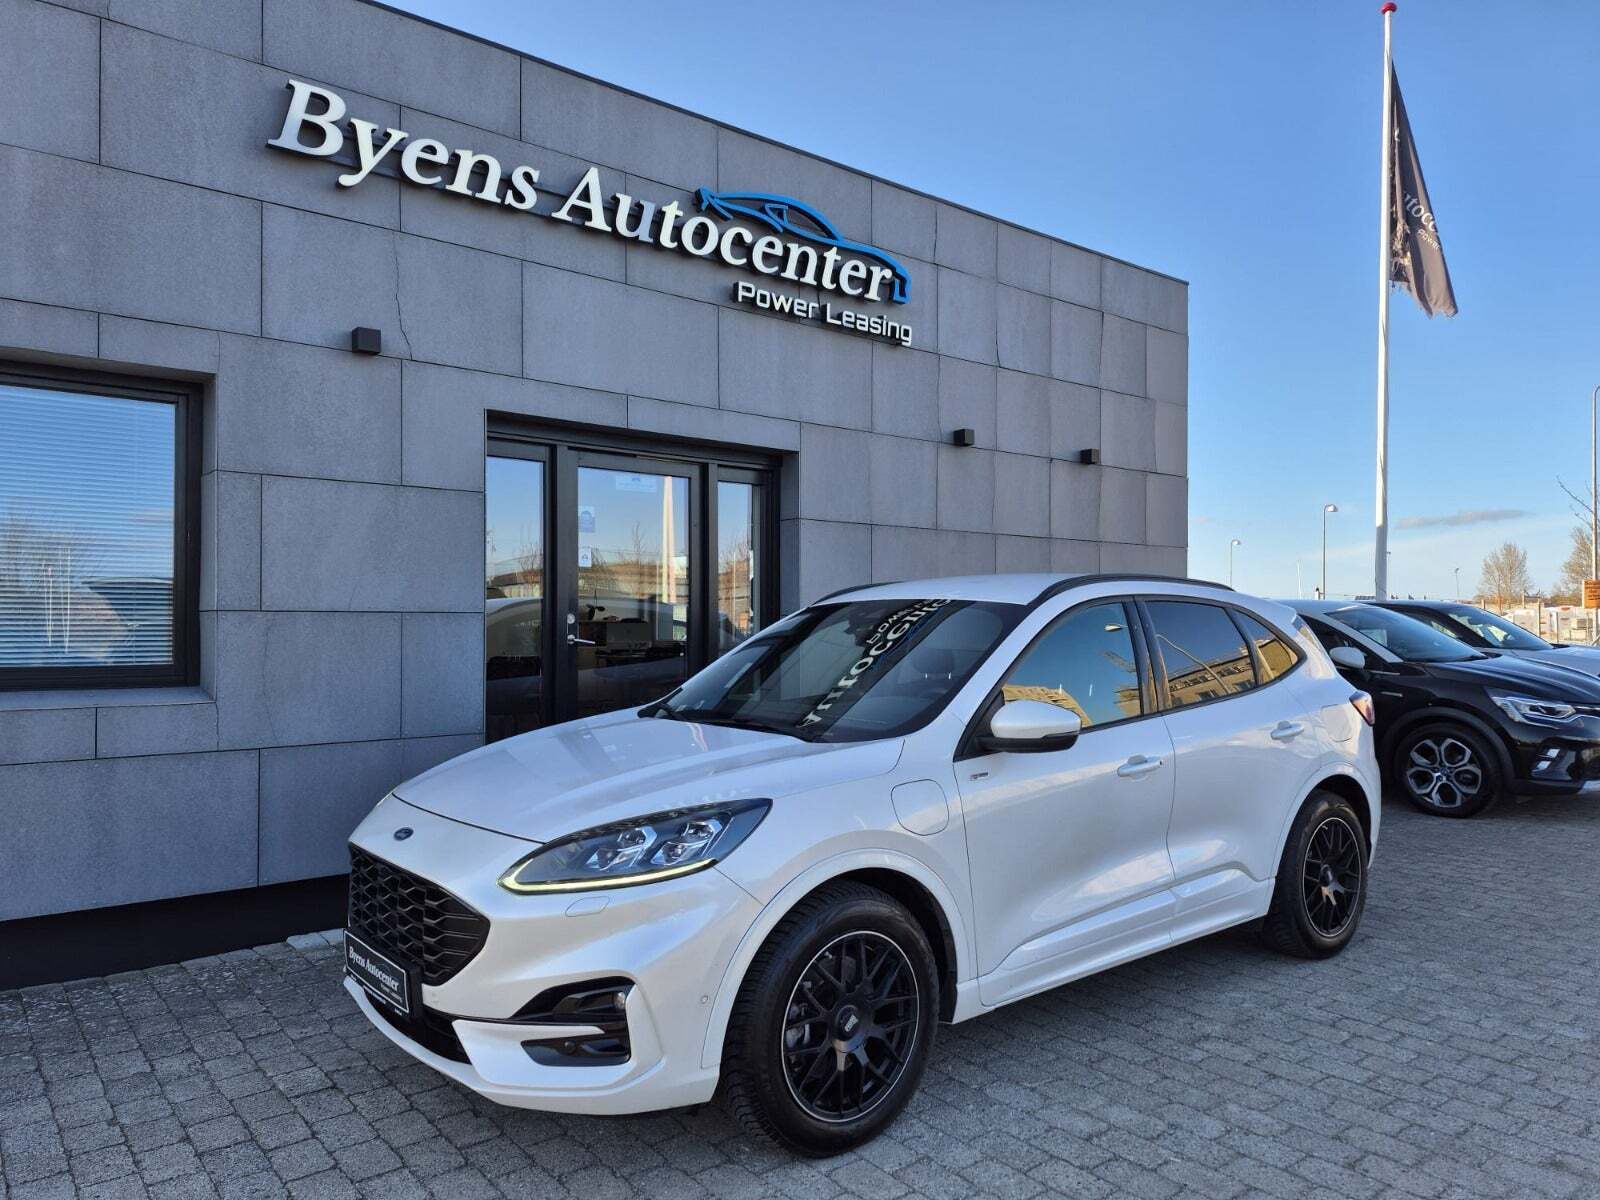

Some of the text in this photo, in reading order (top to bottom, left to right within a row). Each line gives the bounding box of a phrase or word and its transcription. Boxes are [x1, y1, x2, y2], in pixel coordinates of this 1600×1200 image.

[267, 79, 892, 301] Byens Autocenter
[737, 280, 912, 347] Power Leasing
[349, 946, 399, 991] Byens Autocenter
